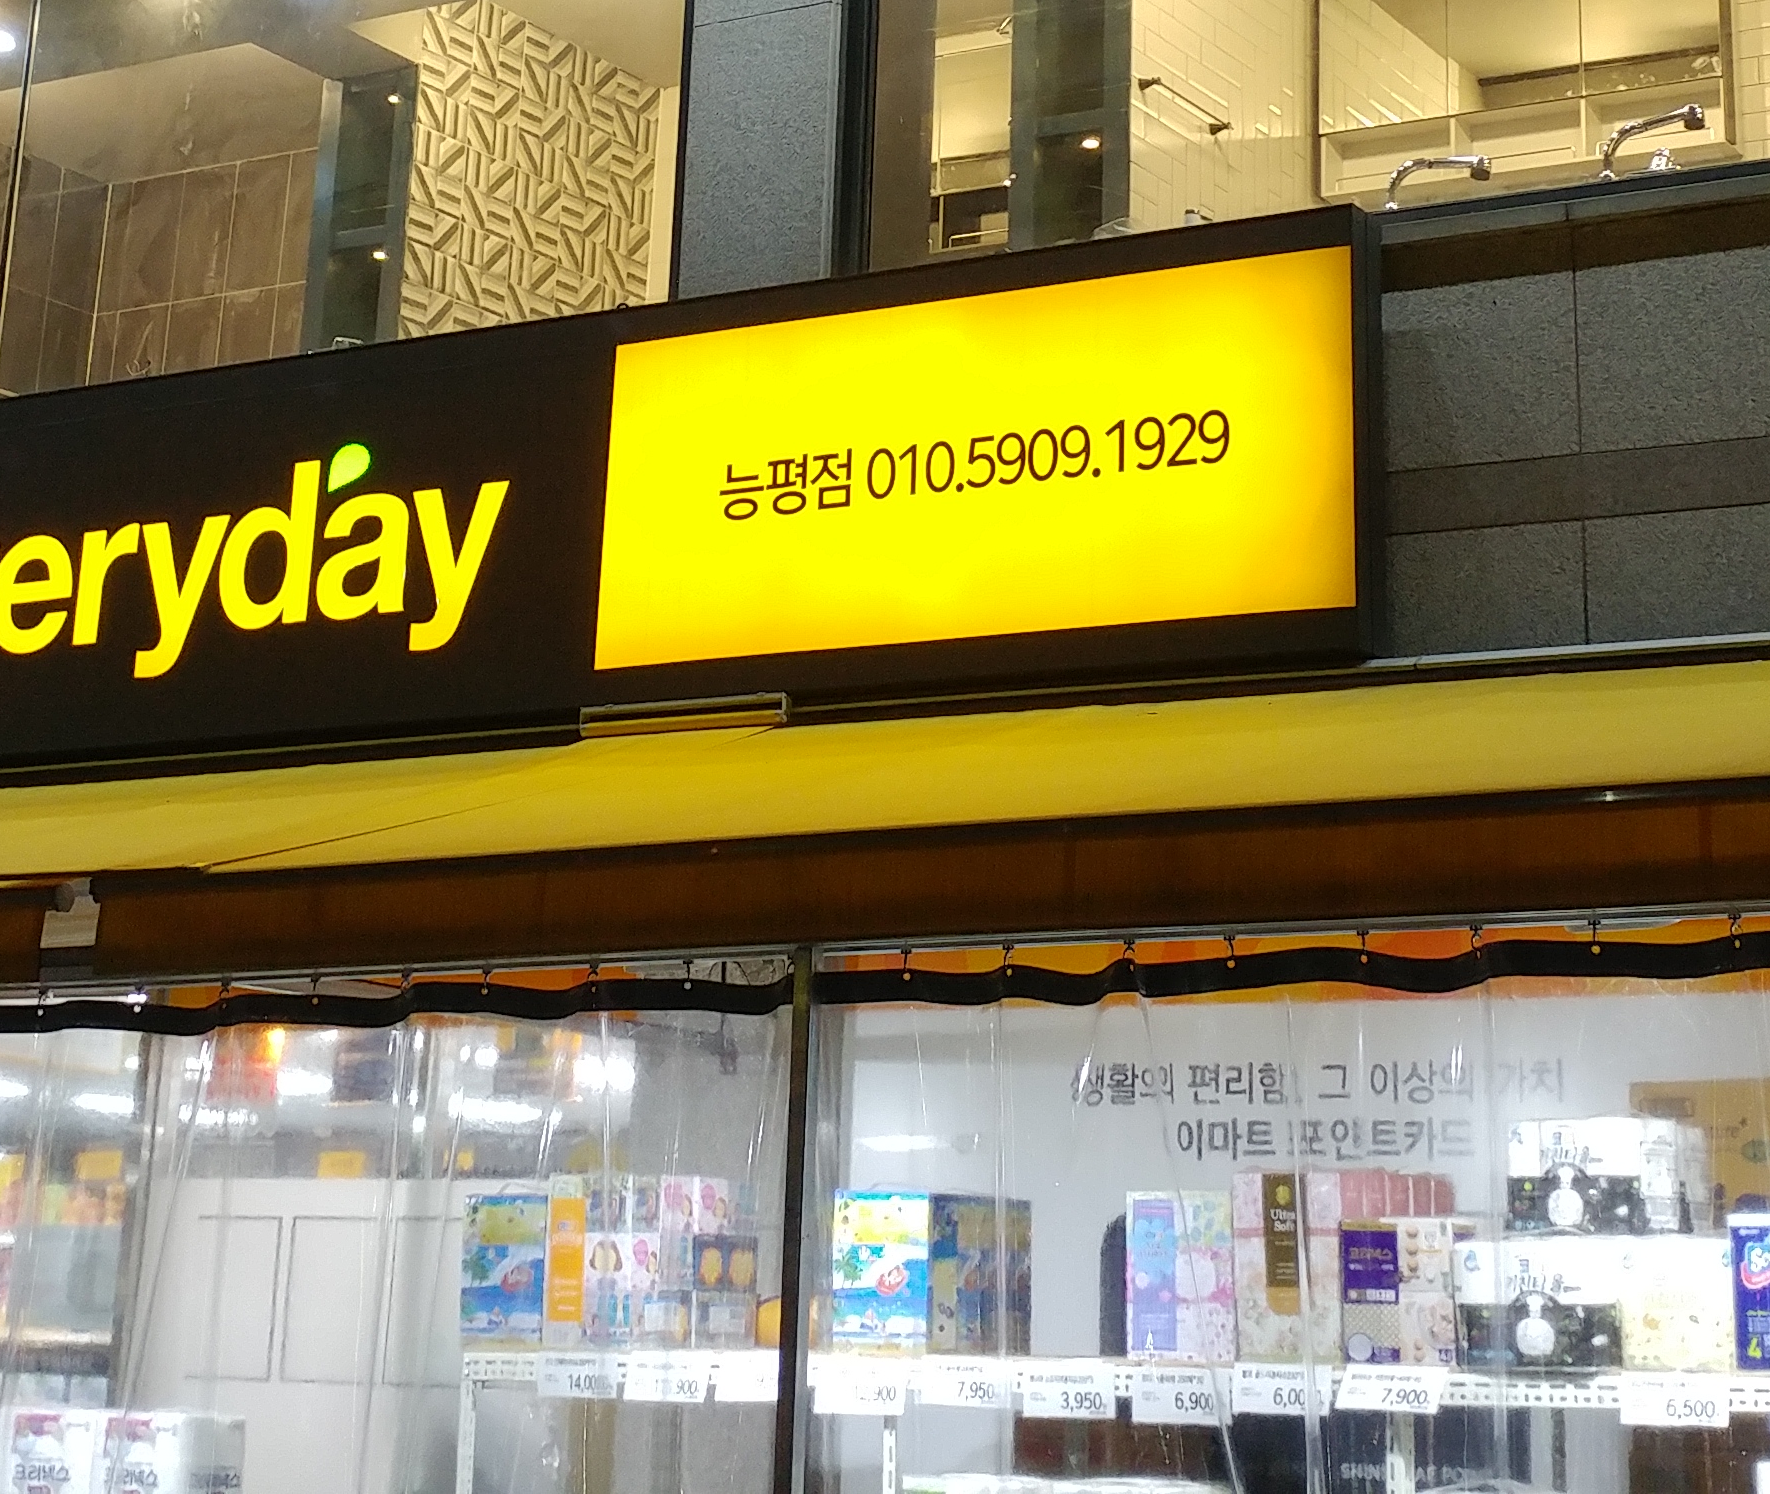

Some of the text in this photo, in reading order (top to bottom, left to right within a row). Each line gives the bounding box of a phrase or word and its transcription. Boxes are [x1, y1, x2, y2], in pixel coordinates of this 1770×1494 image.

[719, 408, 1231, 521] 능평점 010.5909.1929
[1317, 1063, 1352, 1102] 그
[1176, 1116, 1277, 1162] 이마트
[957, 1380, 995, 1401] 7,950
[1059, 1390, 1104, 1413] 3,950
[1174, 1390, 1215, 1412] 6,900
[1380, 1387, 1430, 1407] 7,900
[1665, 1397, 1717, 1421] 6,500
